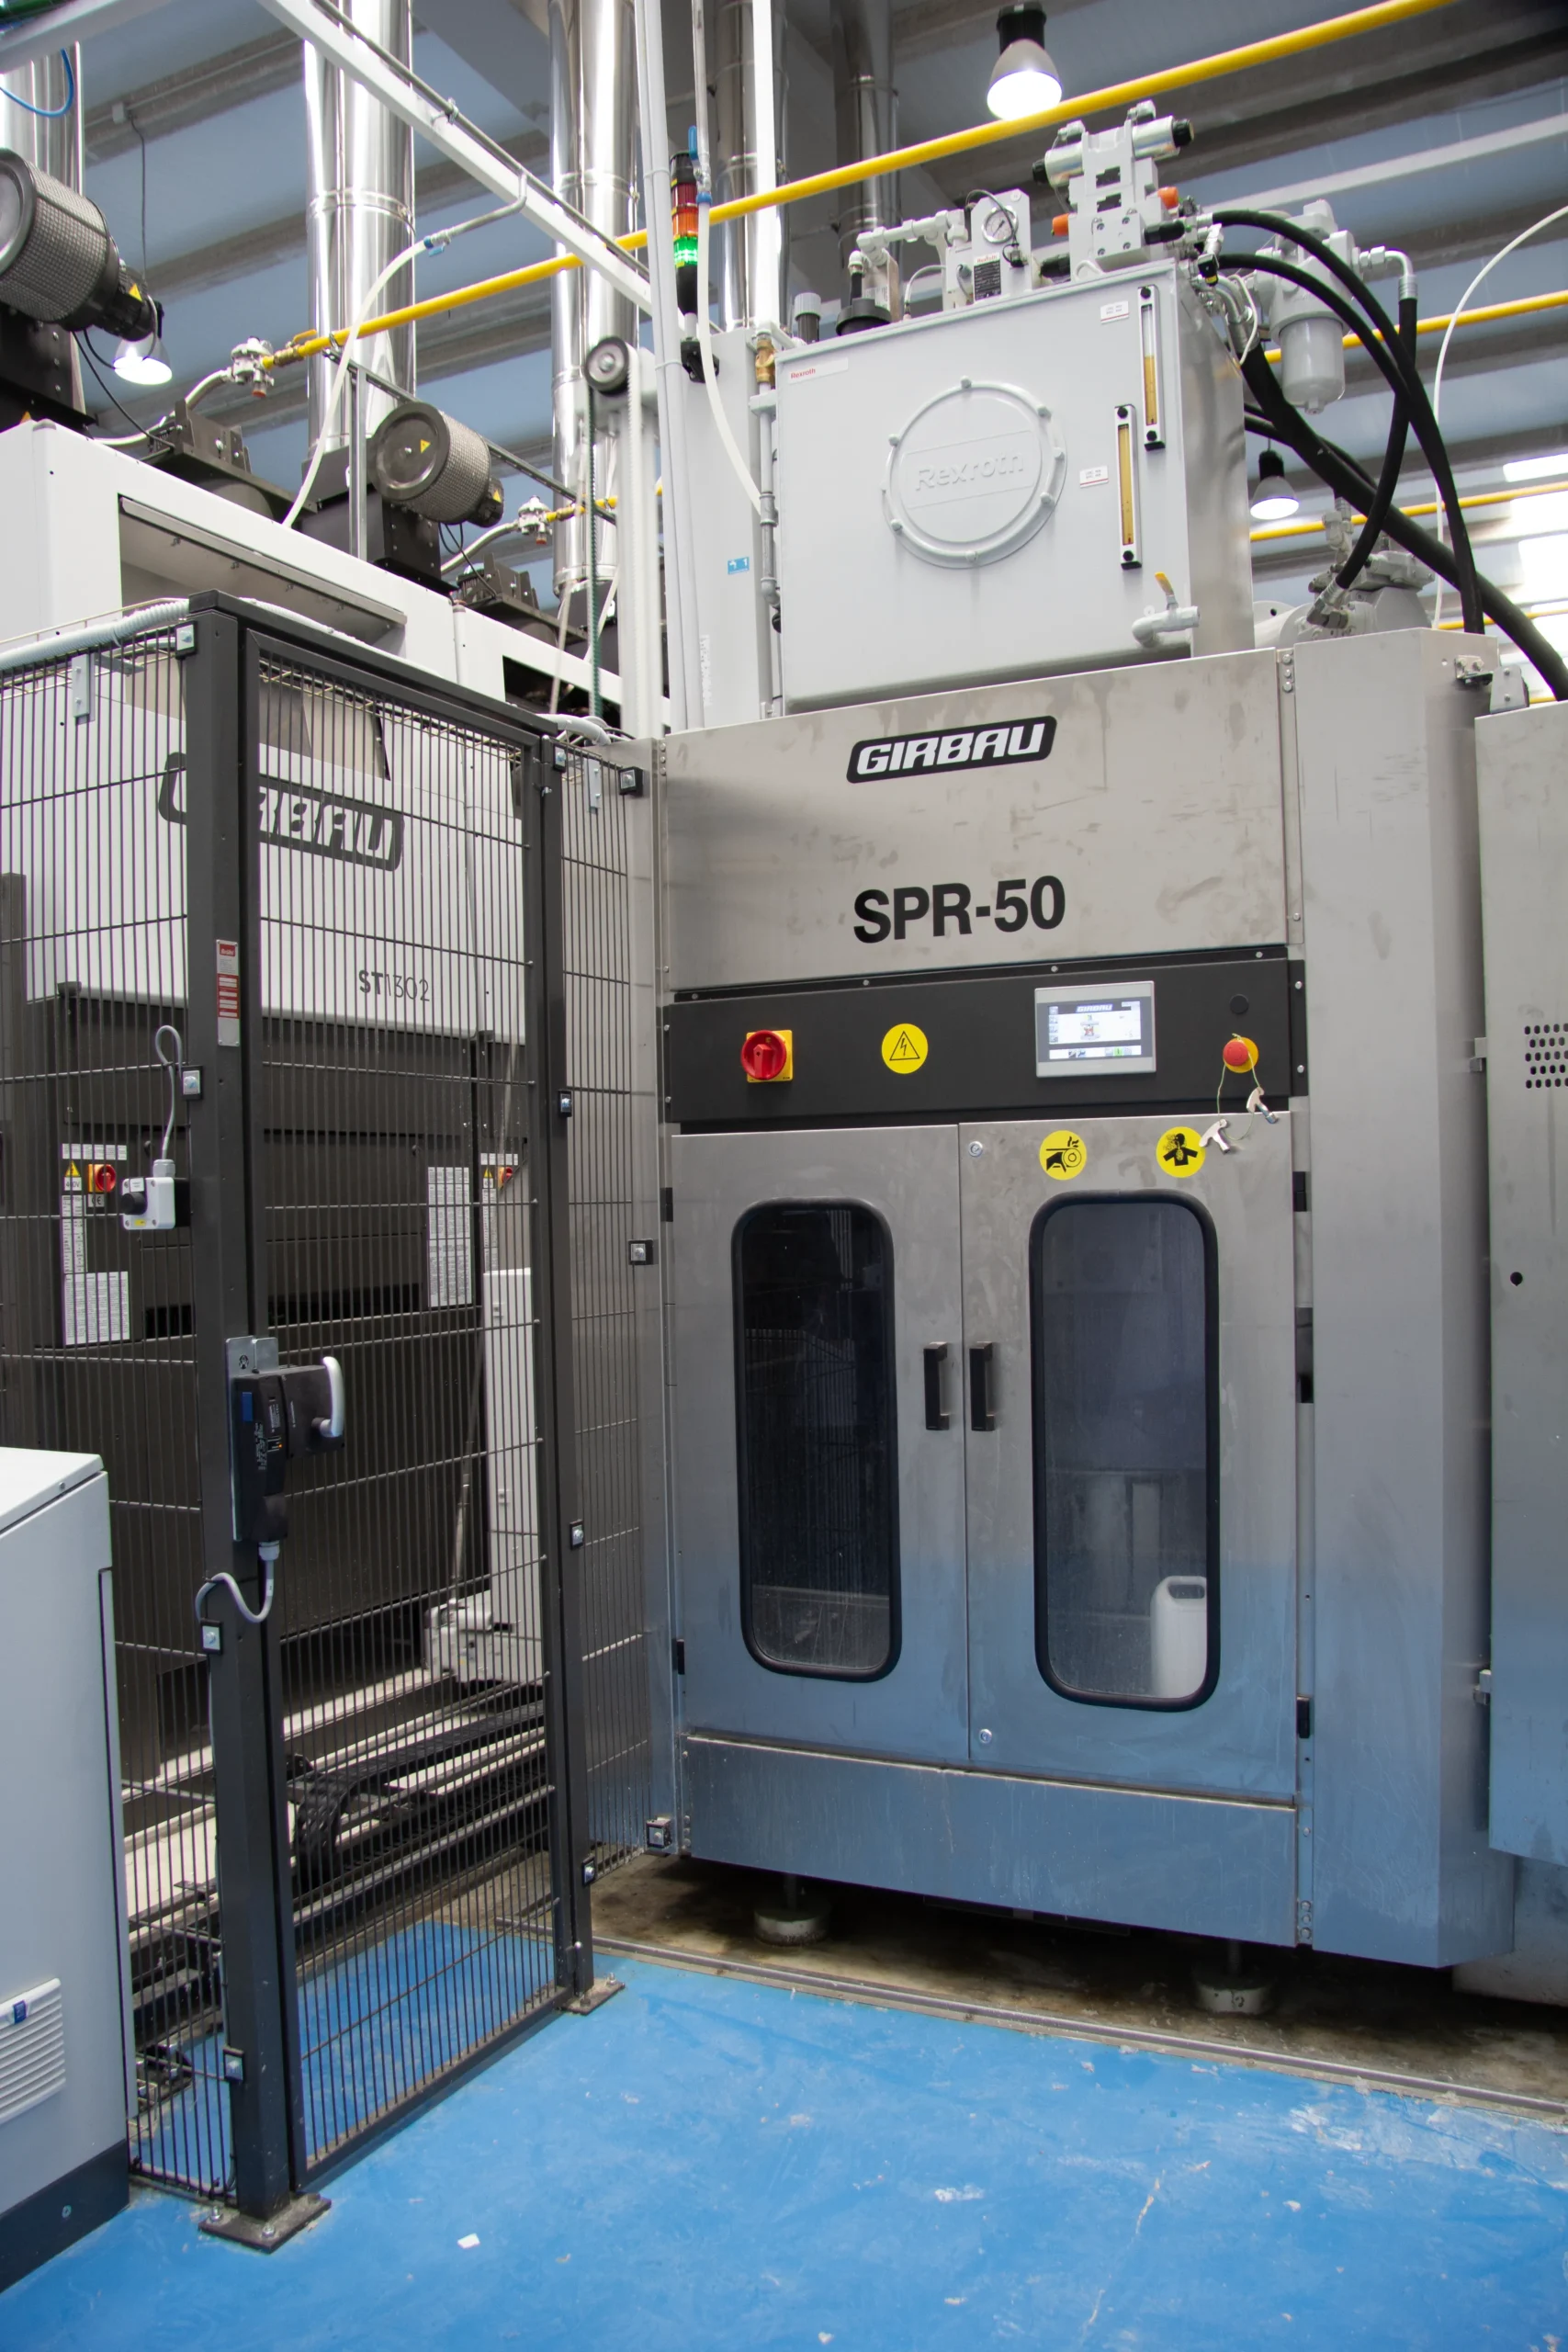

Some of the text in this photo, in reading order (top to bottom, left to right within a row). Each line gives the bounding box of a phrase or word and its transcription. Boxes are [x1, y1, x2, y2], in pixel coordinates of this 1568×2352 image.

[790, 368, 817, 379] Rexroth
[915, 451, 1025, 492] Rexroth
[856, 722, 1045, 775] GIRBAU
[172, 769, 393, 862] RBAU
[853, 875, 1066, 944] SPR-50
[358, 969, 430, 1002] ST1302
